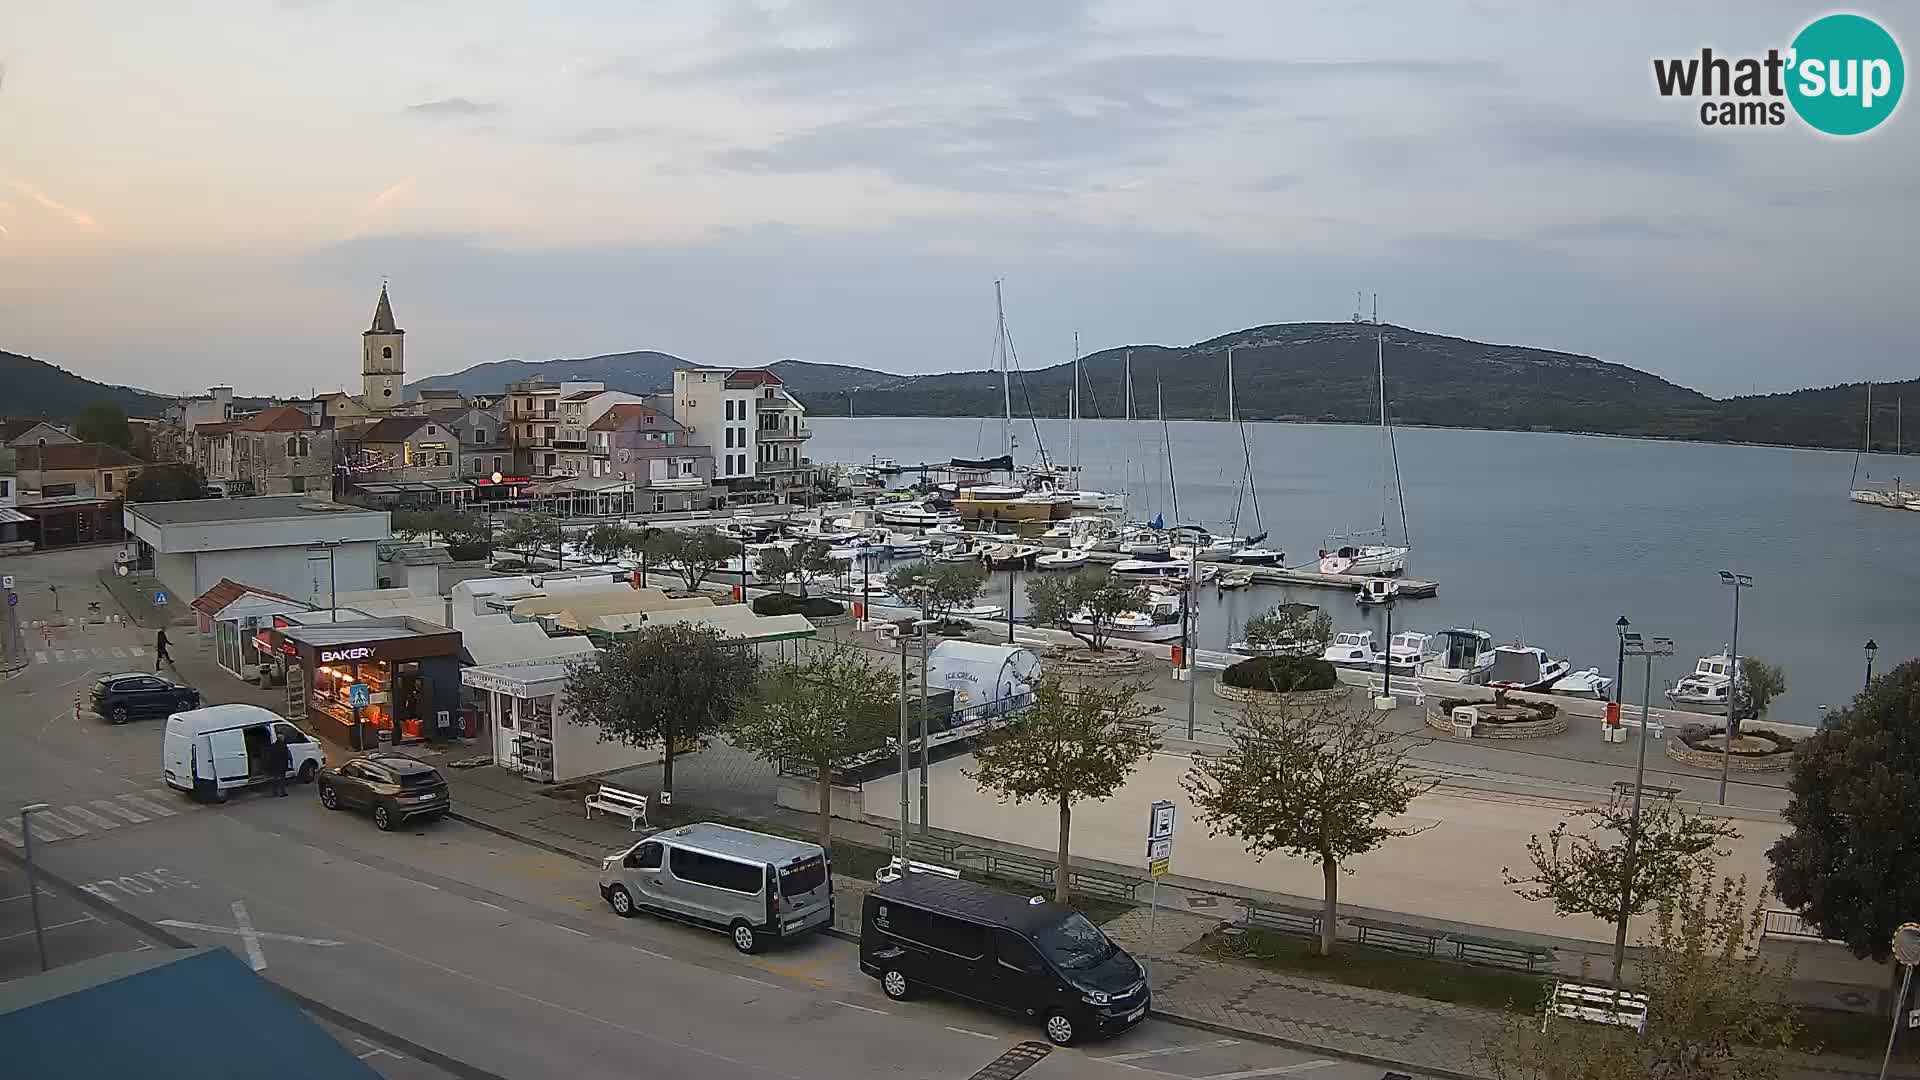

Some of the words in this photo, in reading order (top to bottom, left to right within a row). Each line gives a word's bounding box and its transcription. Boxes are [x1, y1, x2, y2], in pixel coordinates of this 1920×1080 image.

[321, 647, 377, 662] BAKERY
[946, 672, 956, 681] ICE
[957, 672, 979, 682] CREAM
